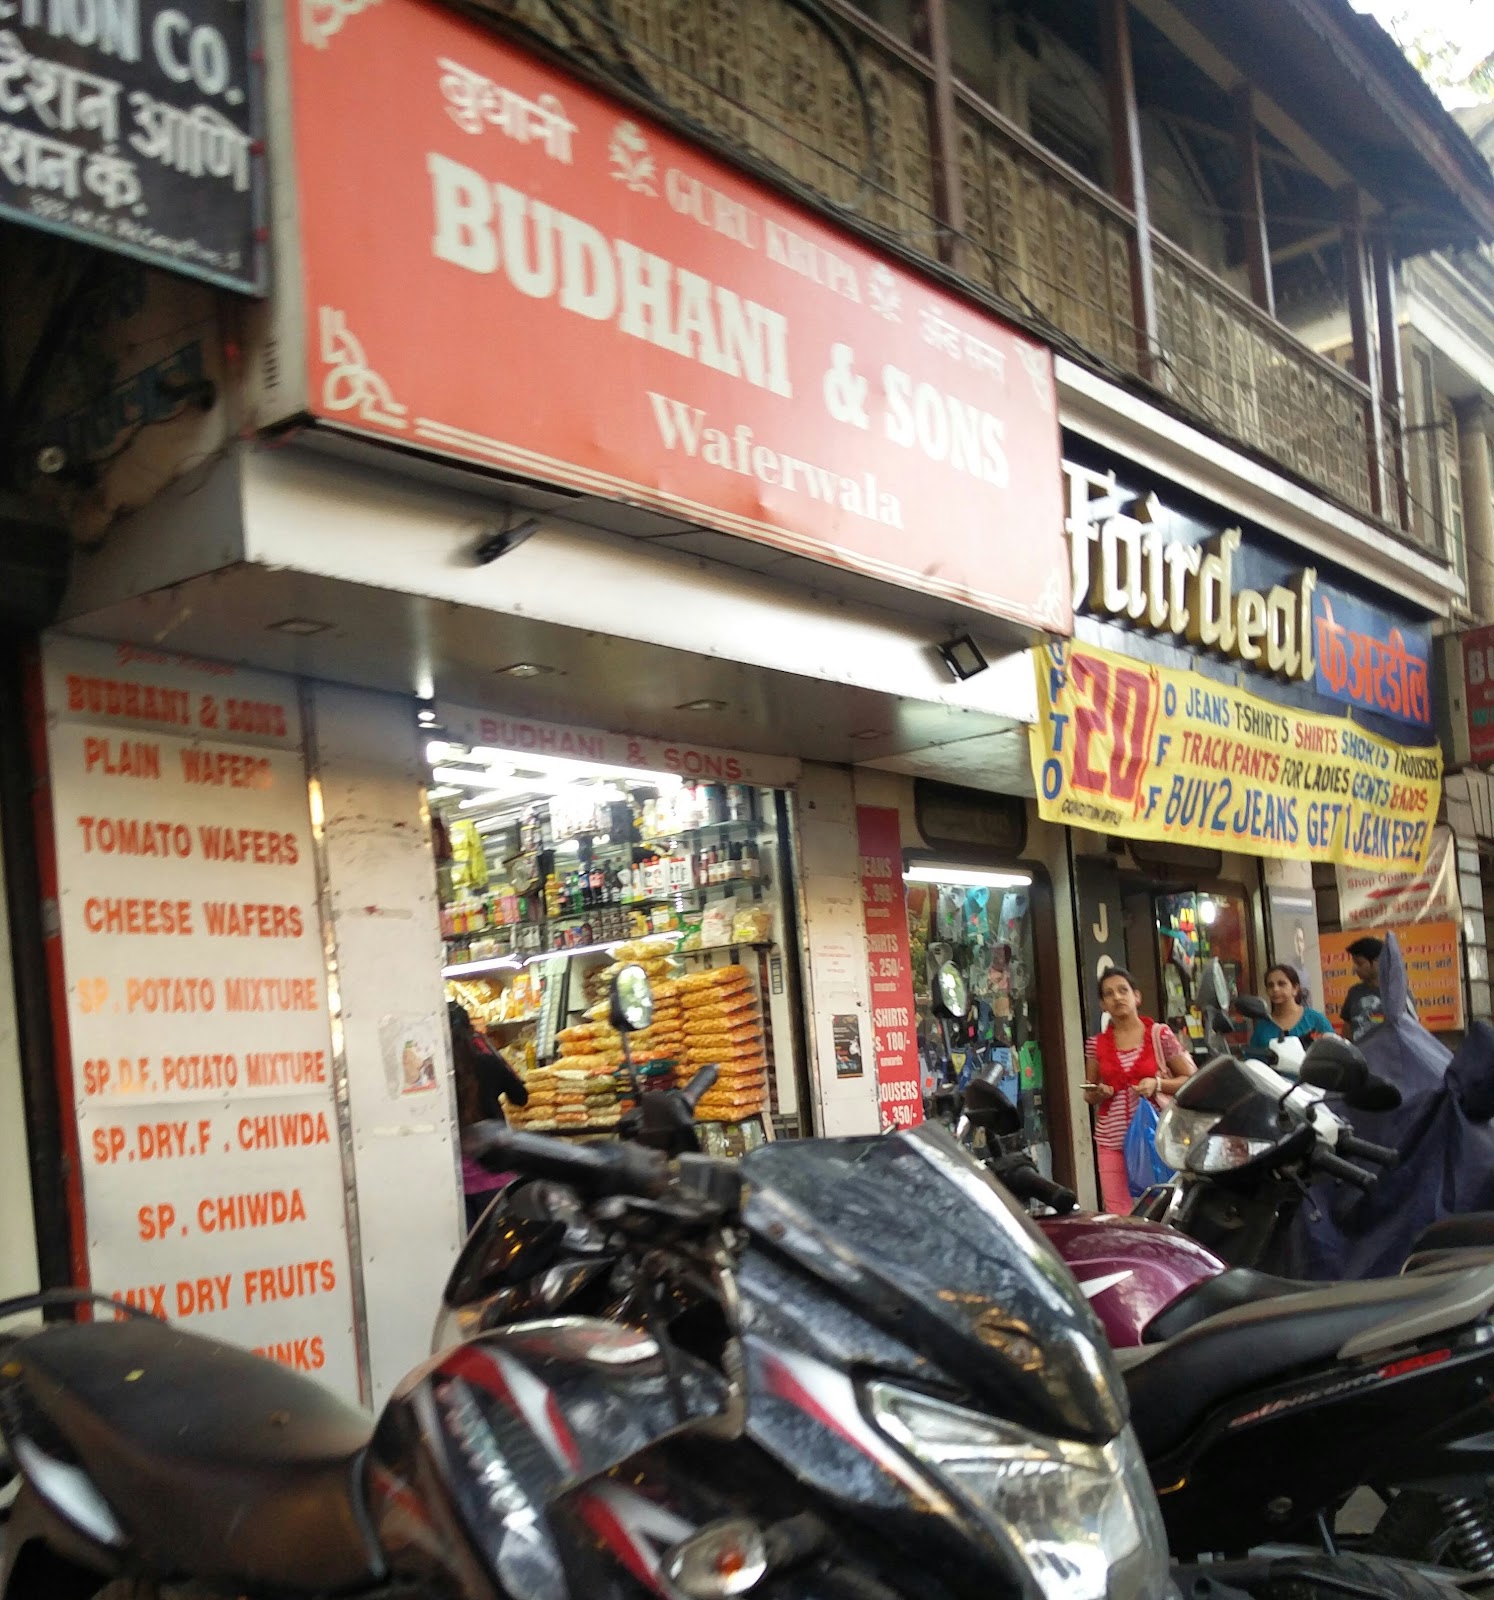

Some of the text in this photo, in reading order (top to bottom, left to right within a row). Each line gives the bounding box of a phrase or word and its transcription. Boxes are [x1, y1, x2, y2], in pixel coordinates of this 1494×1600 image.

[426, 150, 1011, 488] BUDHANI & SONS
[646, 391, 904, 530] Waferwala
[1060, 457, 1318, 682] Fairdeal
[66, 674, 191, 726] BUDHANI
[479, 716, 743, 780] BUDHANI & SONS
[1185, 687, 1230, 728] JEANS
[1295, 721, 1337, 755] SHIRTS
[1341, 730, 1389, 770] SHORTS
[83, 736, 273, 790] PLAIN WAFERS
[1181, 730, 1232, 772] TRACK
[1232, 742, 1281, 784] PANTS
[1280, 757, 1304, 790] FOR
[1304, 763, 1350, 795] LADIES
[1352, 771, 1391, 808] GENTS
[77, 815, 299, 865] TOMATO WAFERS
[1164, 774, 1216, 829] BUY
[1211, 777, 1232, 833] 2
[1233, 788, 1299, 844] JEANS
[1307, 801, 1343, 848] GET
[1352, 811, 1392, 859] JEAN
[862, 856, 893, 878] EANS
[83, 896, 304, 938] CHEESE WAFERS
[126, 978, 215, 1014] POTATO
[225, 977, 320, 1012] MIXTURE
[162, 1054, 238, 1090] POTATO
[247, 1050, 326, 1087] MIXTURE
[879, 1080, 918, 1103] OUSERS
[238, 1111, 331, 1151] CHIWDA
[196, 1188, 307, 1233] CHIWDA
[112, 1258, 337, 1322] MIX DRY FRUITS
[251, 1335, 325, 1372] INKS
